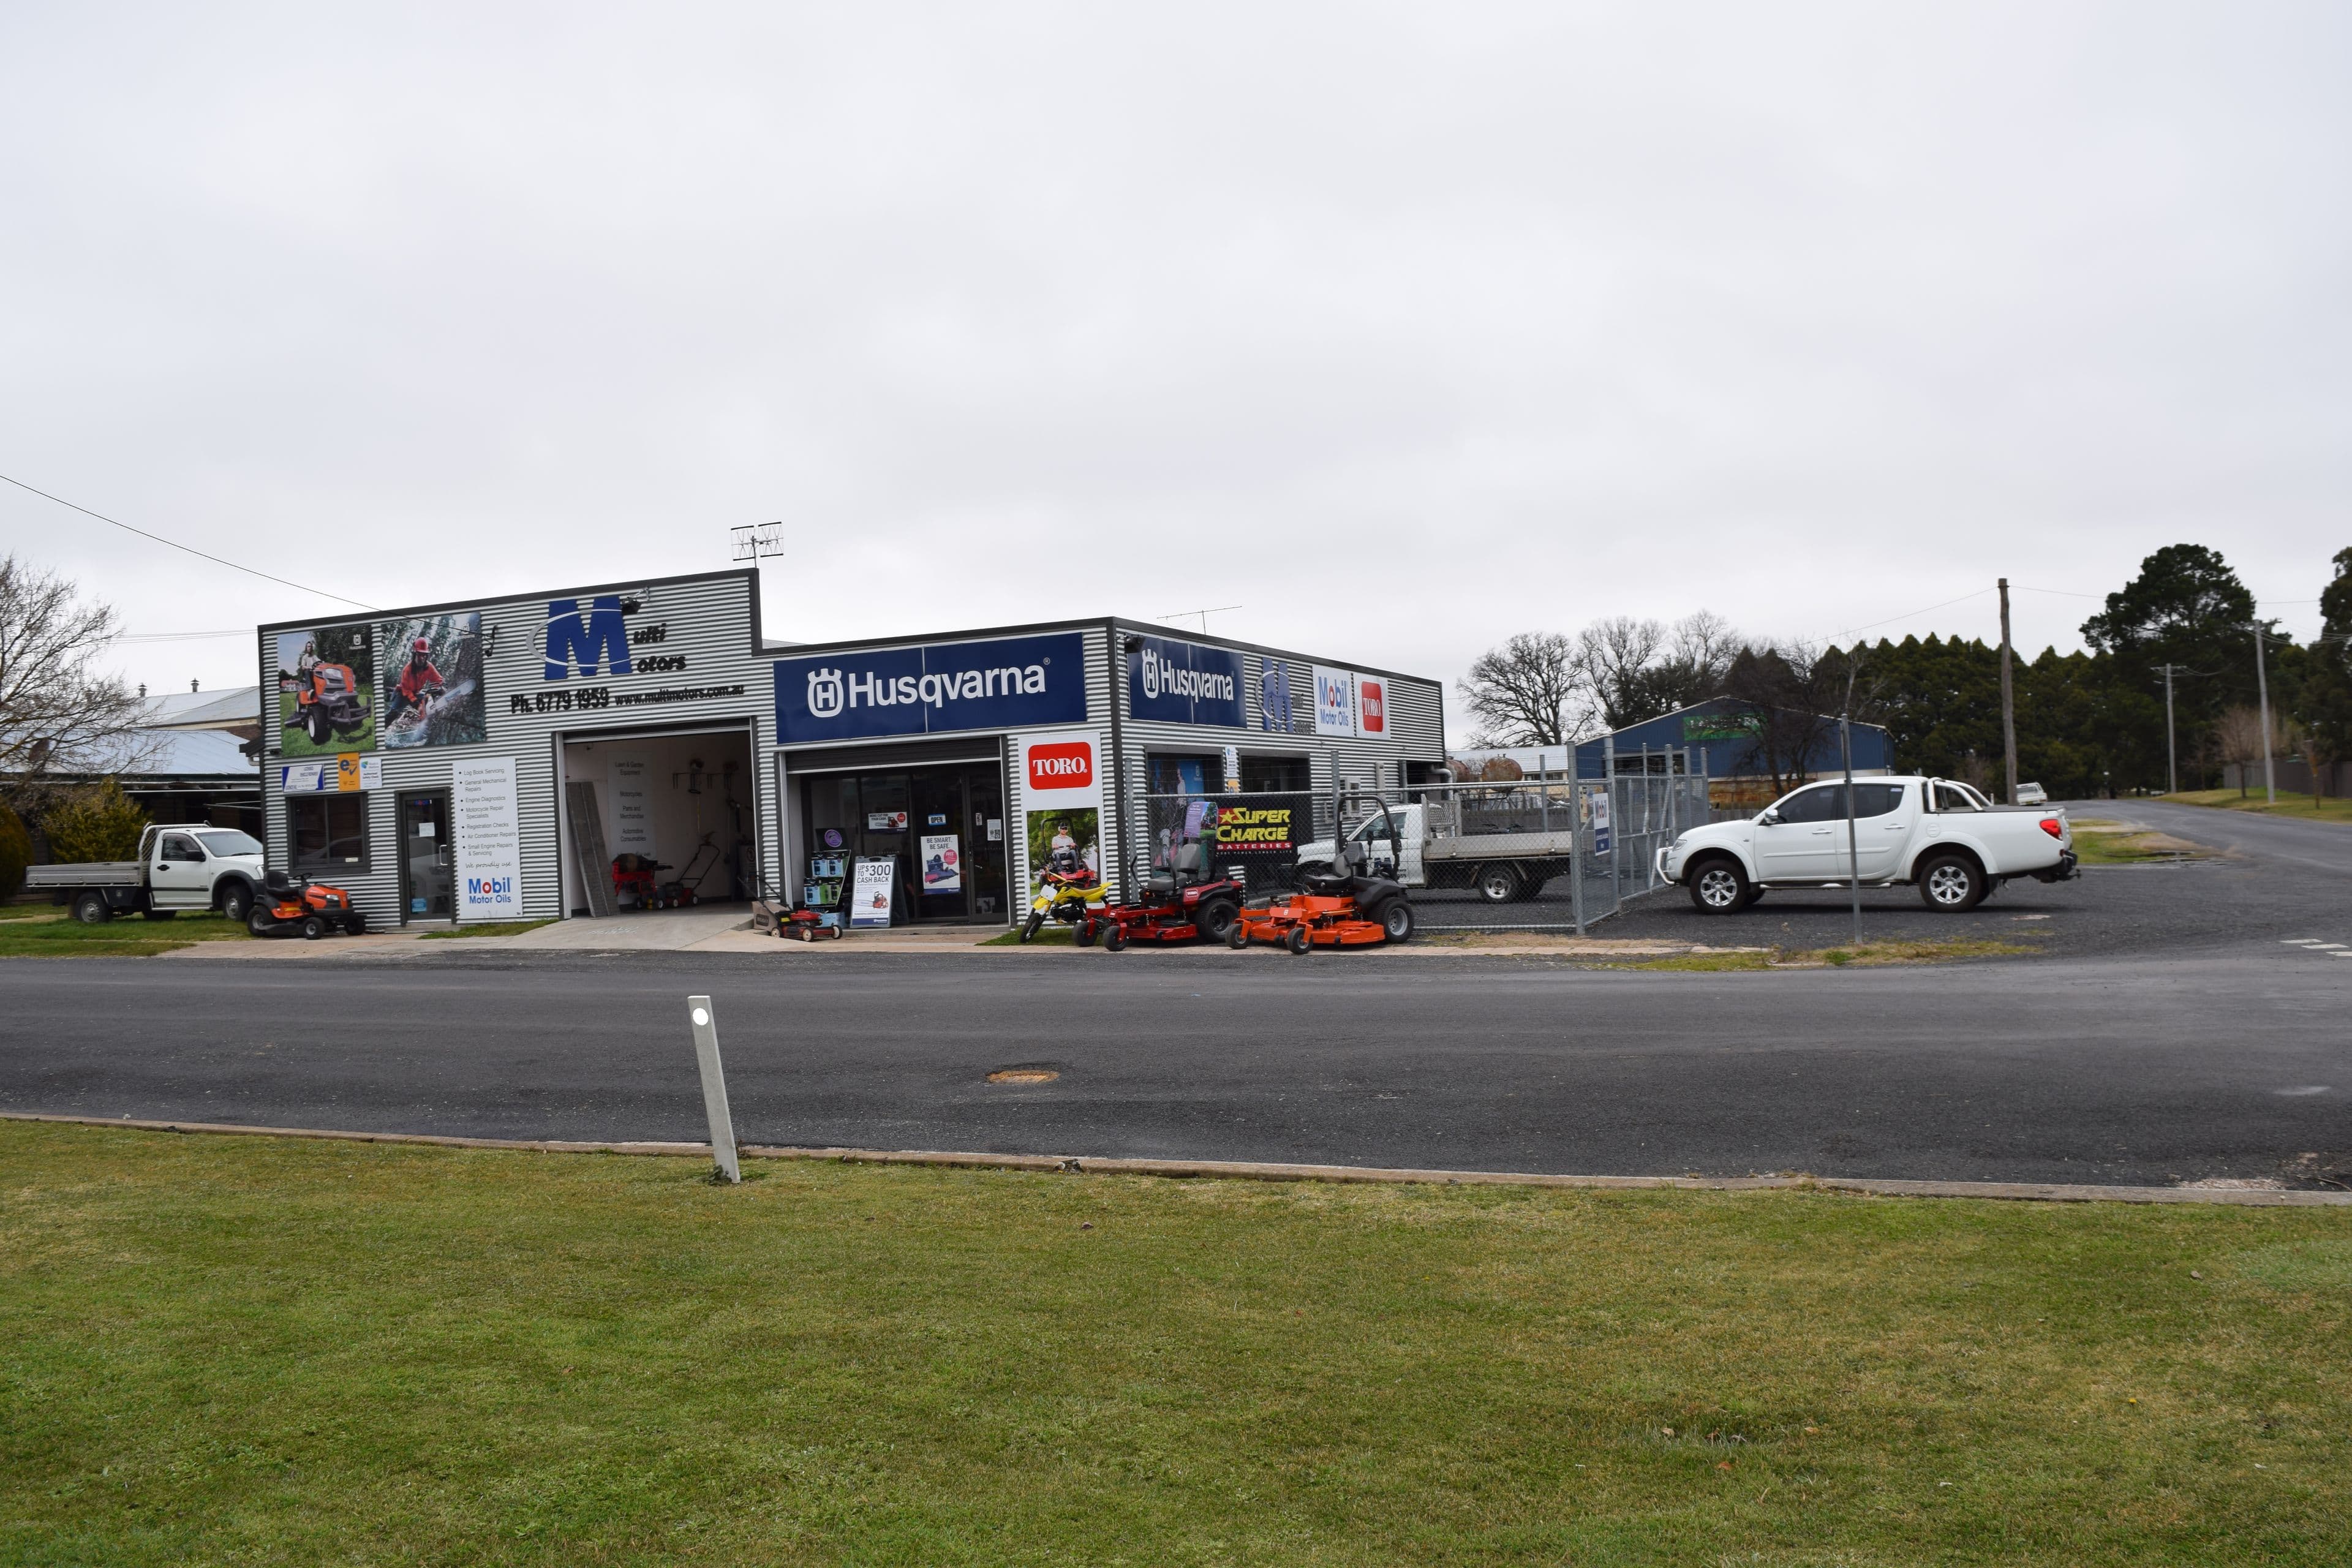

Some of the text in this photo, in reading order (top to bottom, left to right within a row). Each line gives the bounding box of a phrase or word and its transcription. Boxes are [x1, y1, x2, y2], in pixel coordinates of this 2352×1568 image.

[633, 623, 667, 643] ulti
[637, 655, 687, 673] otors
[849, 665, 1046, 708] Husqvarna
[1160, 658, 1234, 703] Husqvarna
[511, 684, 745, 714] Ph. 6779 1959 www.multimotors.com.au
[1318, 676, 1348, 708] Mobil
[1363, 697, 1381, 717] TORO
[1321, 709, 1349, 726] Motor Oils
[1033, 756, 1086, 776] TORO
[1232, 807, 1291, 824] SUPER
[1216, 826, 1288, 842] CHARGE
[468, 877, 511, 894] Mobil
[469, 894, 511, 904] Motor Oils
